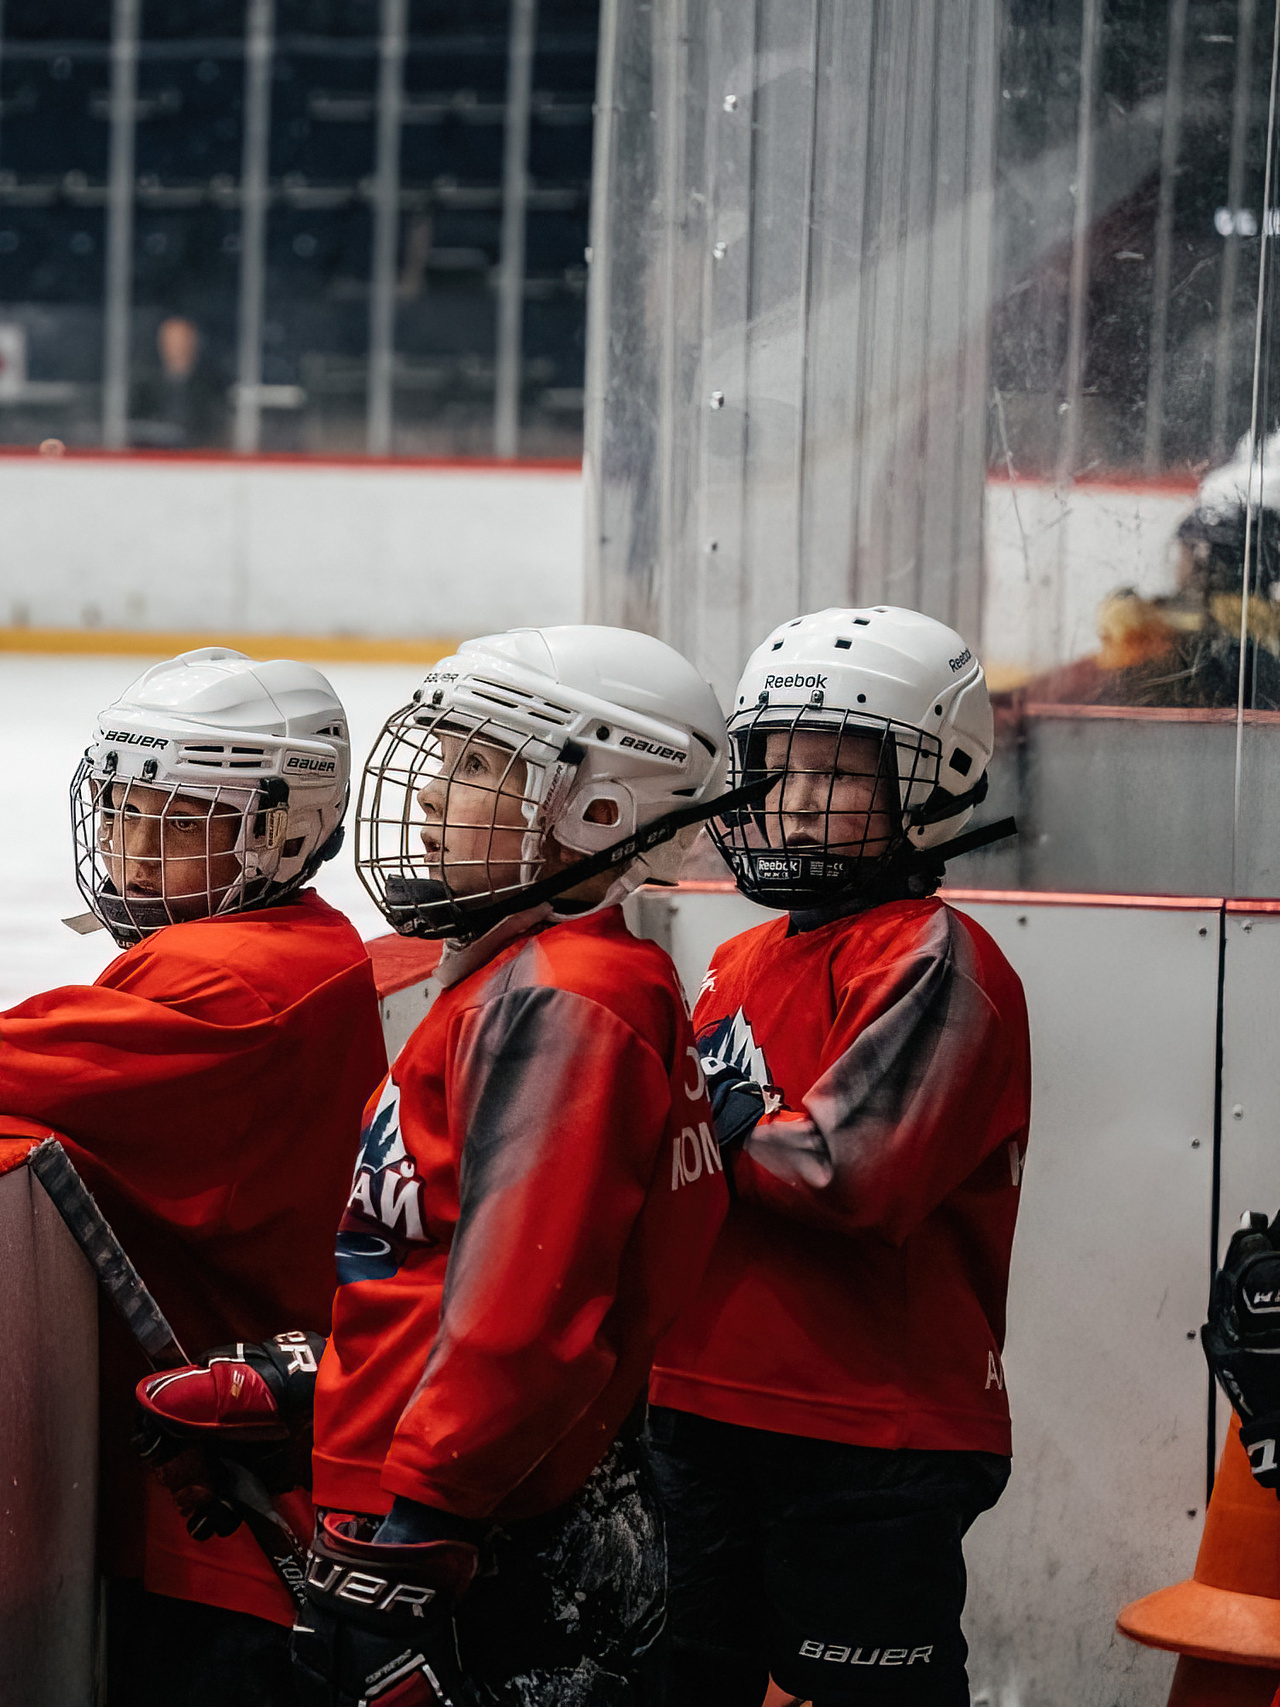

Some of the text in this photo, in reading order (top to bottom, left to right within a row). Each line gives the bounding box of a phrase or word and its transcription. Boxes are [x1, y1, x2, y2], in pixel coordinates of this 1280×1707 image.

[764, 673, 828, 689] Reebok
[105, 730, 169, 750] BAUER
[620, 735, 687, 763] BAUER
[287, 757, 335, 772] BAUER
[798, 1639, 934, 1666] BAUER
